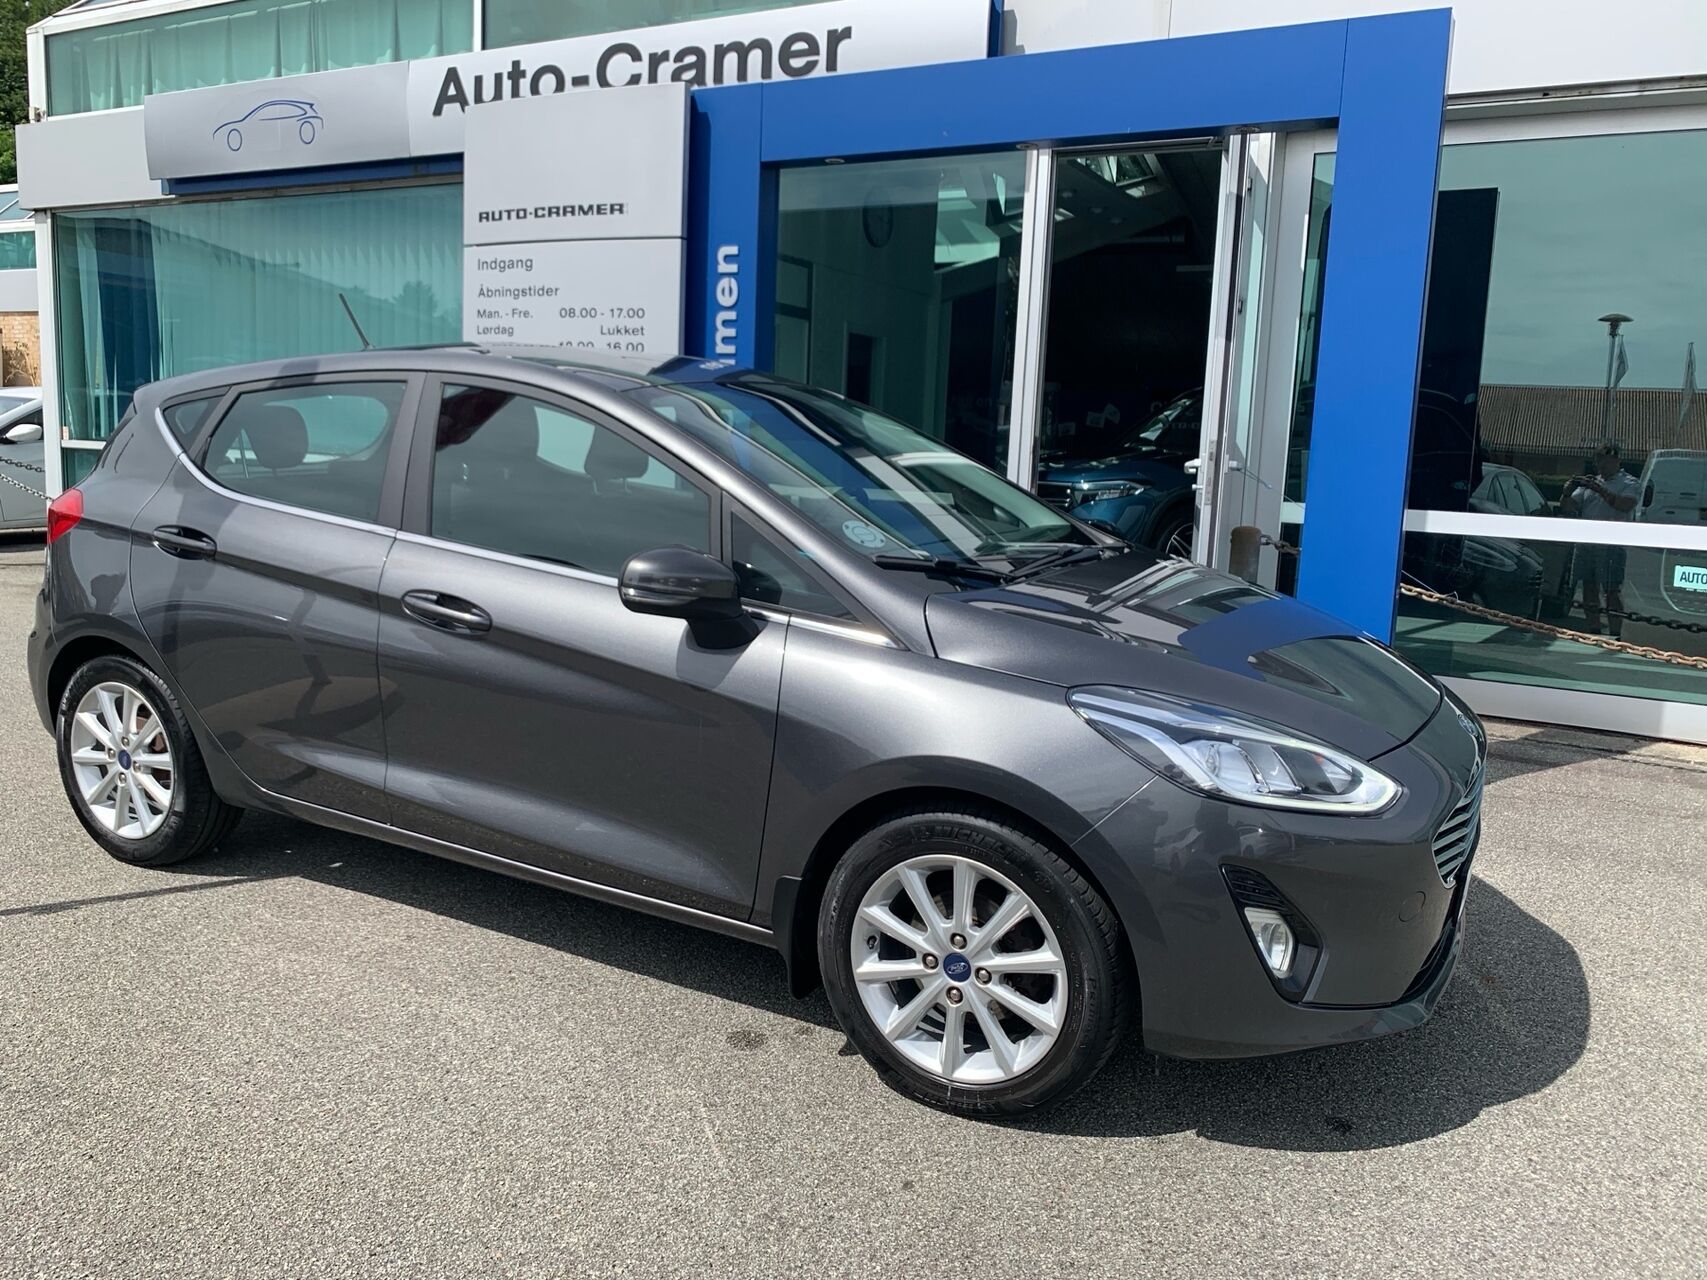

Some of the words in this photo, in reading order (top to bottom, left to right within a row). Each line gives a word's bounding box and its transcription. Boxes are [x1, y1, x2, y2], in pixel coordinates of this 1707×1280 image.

[432, 25, 852, 116] Auto-Cramer
[477, 258, 534, 272] Indgang
[477, 284, 560, 299] Åbningstider
[477, 308, 503, 319] Man.
[511, 308, 534, 319] Fre.
[559, 307, 598, 319] 08.00
[609, 307, 646, 319] 17.00
[477, 325, 515, 337] Lørdag
[600, 325, 645, 336] Lukket
